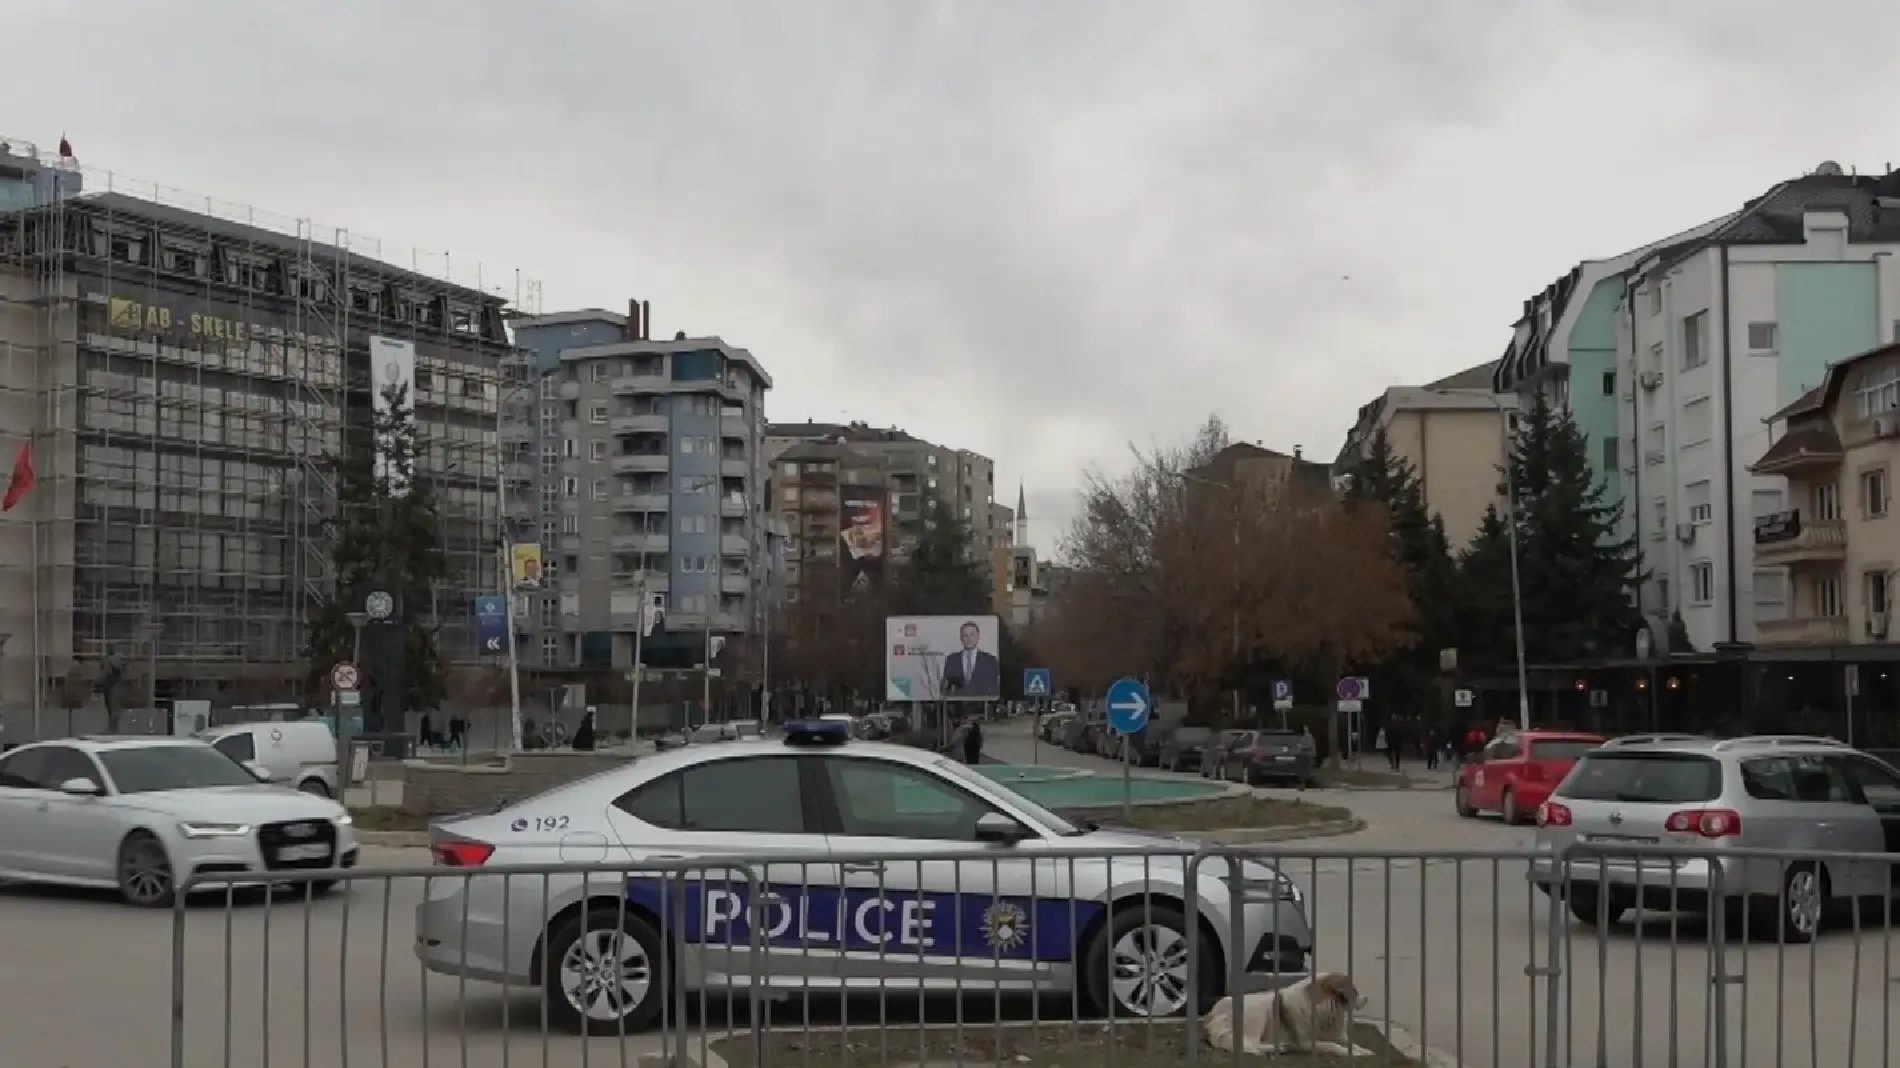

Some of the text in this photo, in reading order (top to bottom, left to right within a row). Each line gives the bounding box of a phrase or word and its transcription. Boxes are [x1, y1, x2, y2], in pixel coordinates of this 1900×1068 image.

[147, 306, 171, 329] AB
[536, 815, 569, 832] 192
[706, 890, 936, 946] POLICE
